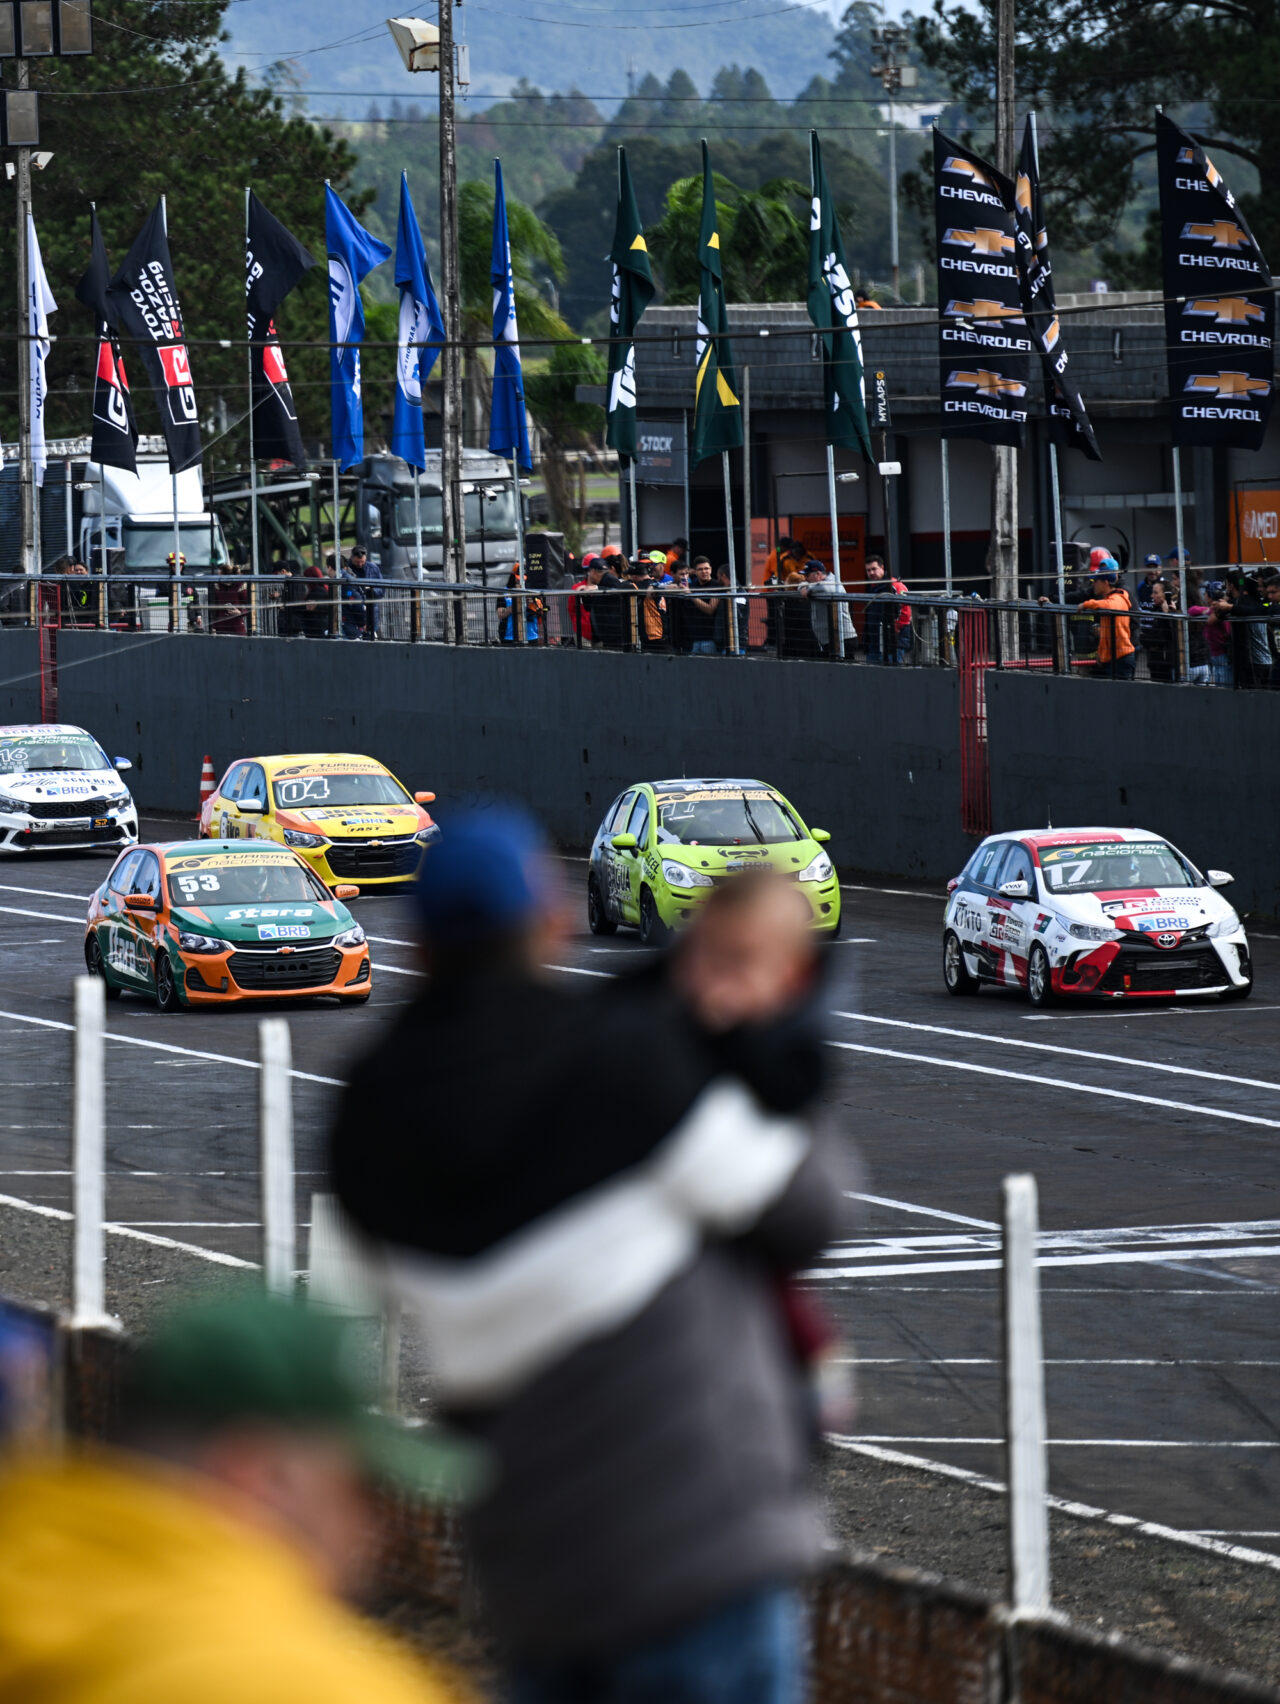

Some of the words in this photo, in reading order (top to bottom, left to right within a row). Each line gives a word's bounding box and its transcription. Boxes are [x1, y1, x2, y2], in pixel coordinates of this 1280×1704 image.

[941, 257, 1018, 278] CHEVROL
[942, 329, 1031, 351] CHEVROLET
[171, 348, 198, 420] GR
[877, 378, 889, 423] MYLAPS
[944, 400, 1027, 422] CHEVROLET
[1182, 406, 1261, 422] CHEVROL
[641, 435, 673, 452] STOCK
[62, 786, 89, 795] BRB
[282, 778, 330, 802] 04
[1082, 849, 1162, 857] nacional
[1043, 859, 1092, 886] 17
[177, 874, 221, 893] 53
[224, 908, 313, 920] Stara
[1102, 899, 1148, 914] GR
[953, 906, 982, 932] KINTO
[1156, 917, 1190, 929] BRB
[277, 926, 310, 937] BRB
